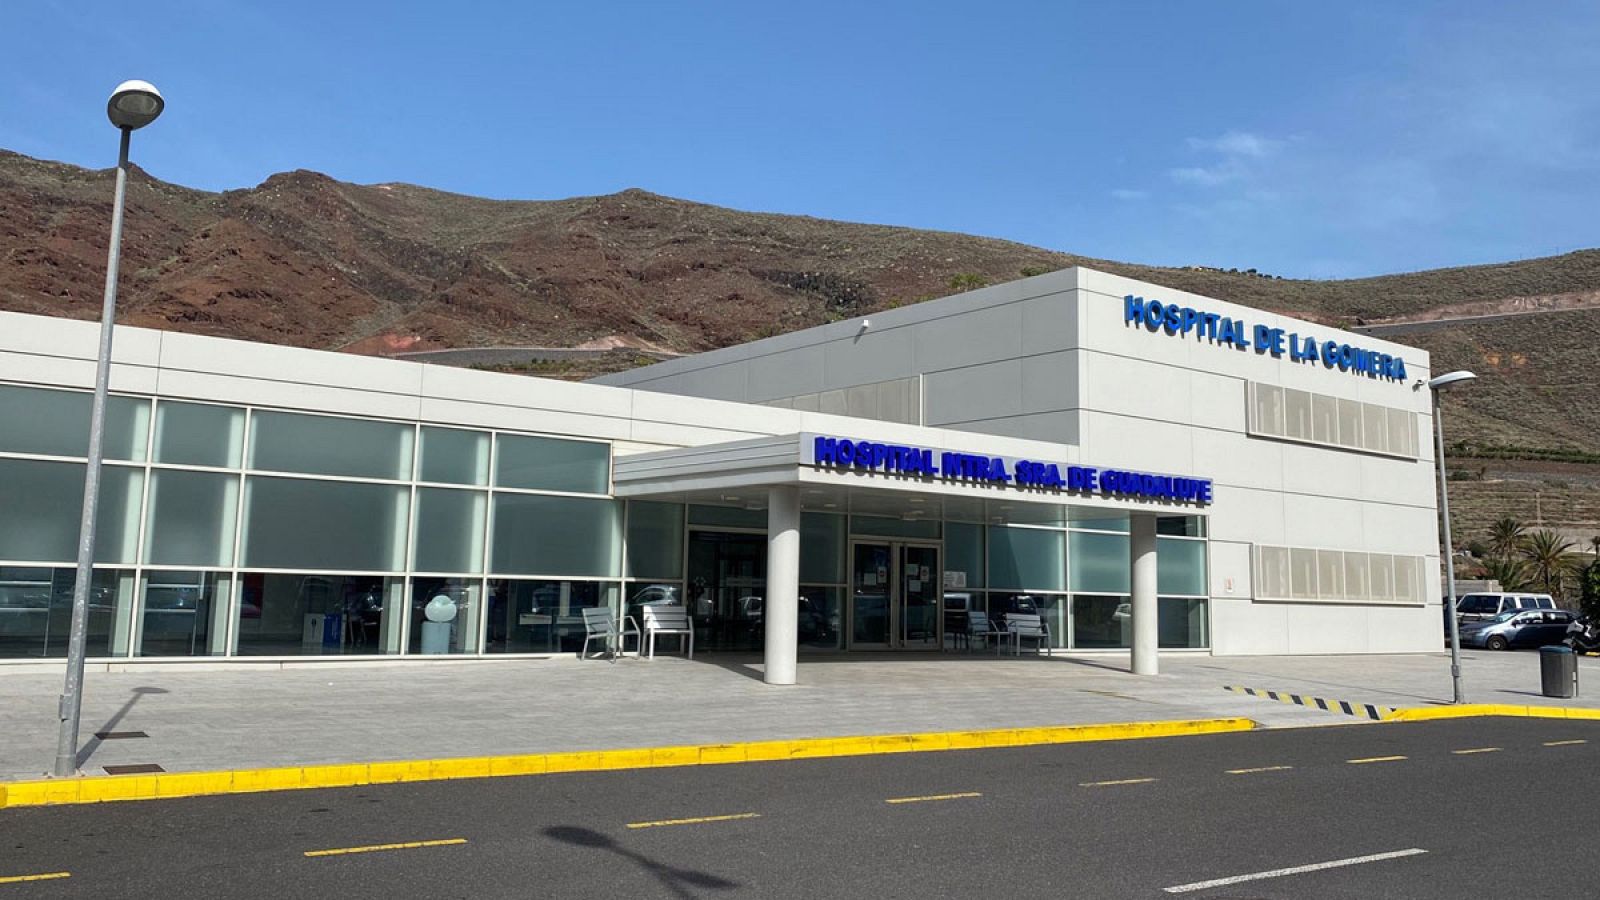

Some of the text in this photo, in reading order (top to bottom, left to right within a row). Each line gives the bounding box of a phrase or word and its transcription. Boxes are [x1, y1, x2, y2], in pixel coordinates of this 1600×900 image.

[1124, 295, 1408, 380] HOSPITAL DE LA GOMERA
[814, 436, 1212, 503] HOSPITAL NTRA. SRA. DE GUADALUPE
